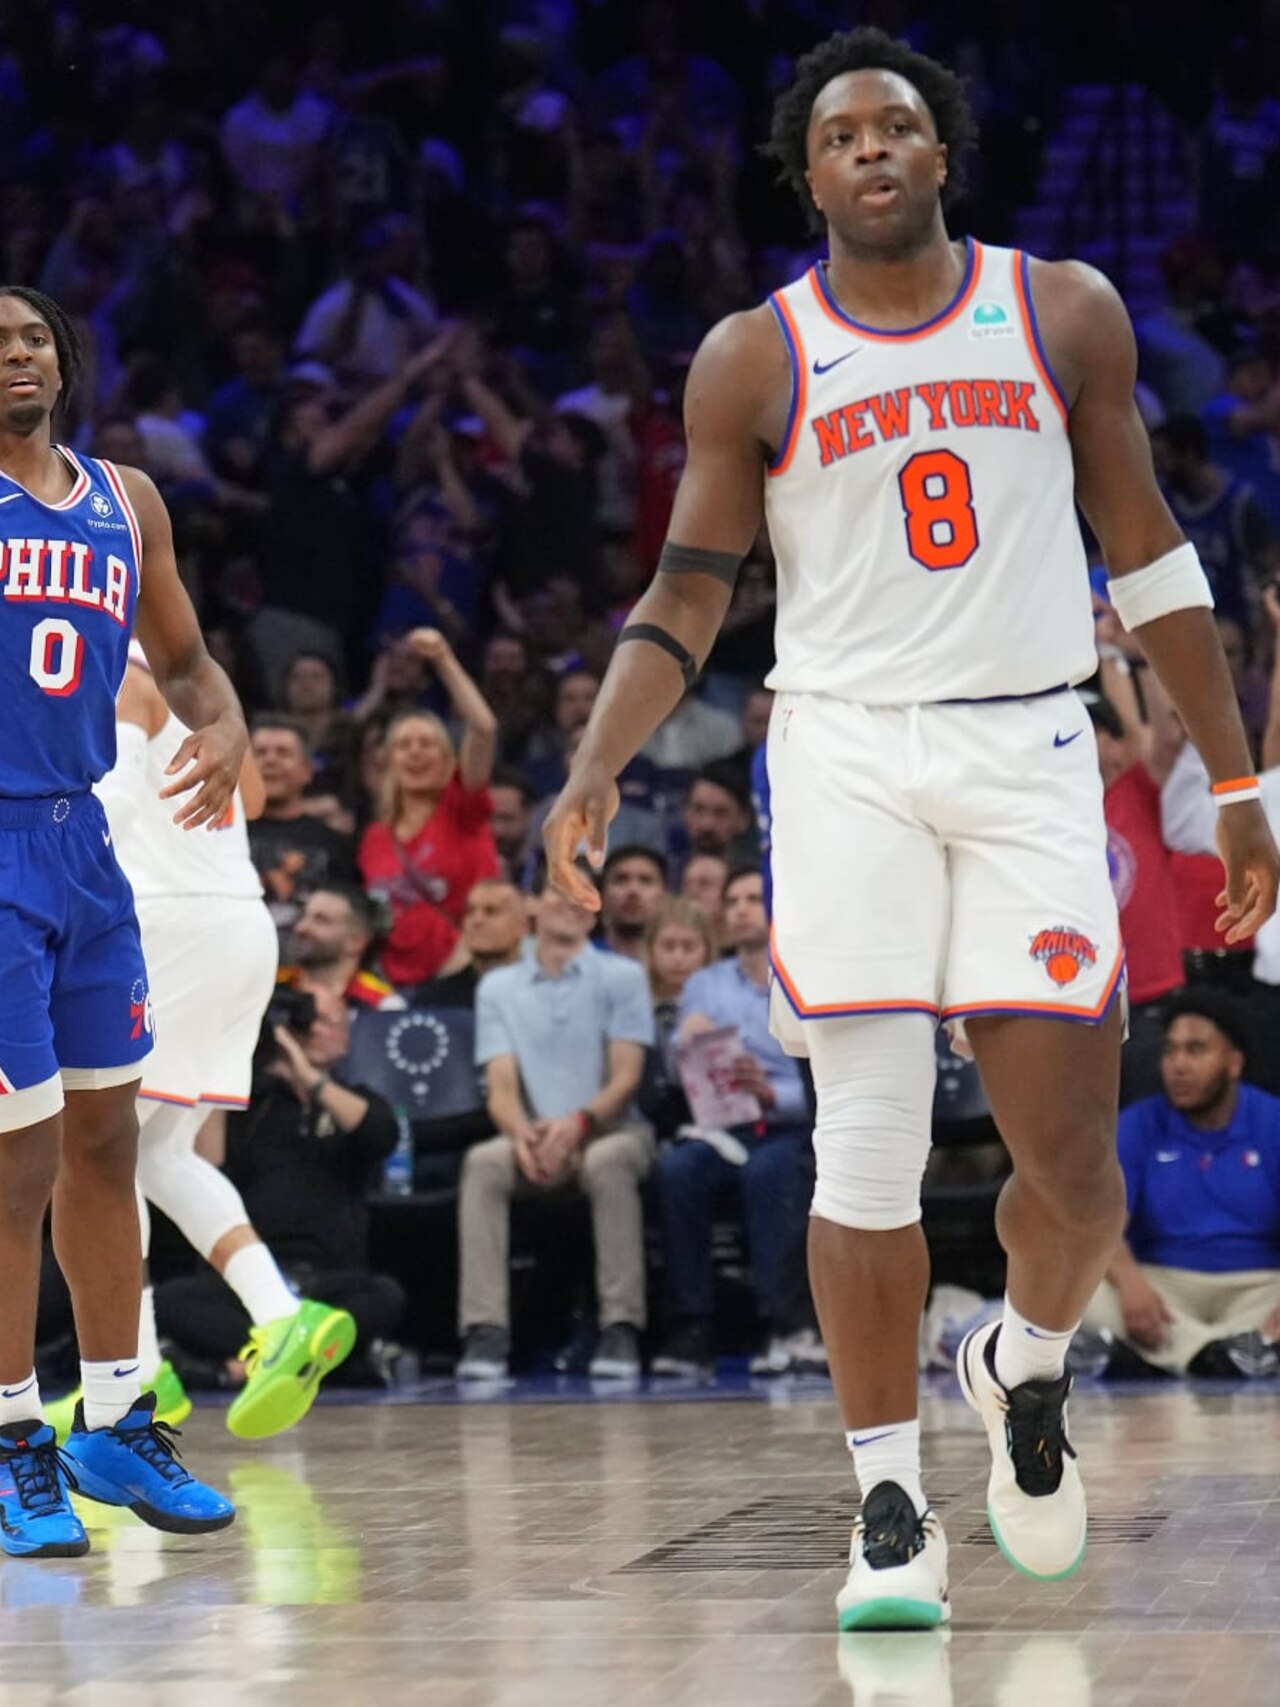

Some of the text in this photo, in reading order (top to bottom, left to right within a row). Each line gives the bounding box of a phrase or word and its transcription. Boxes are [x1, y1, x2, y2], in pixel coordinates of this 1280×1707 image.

[811, 379, 1040, 468] NEW YORK
[897, 448, 980, 572] 8
[29, 617, 85, 698] 0
[1028, 929, 1097, 966] KNICKS
